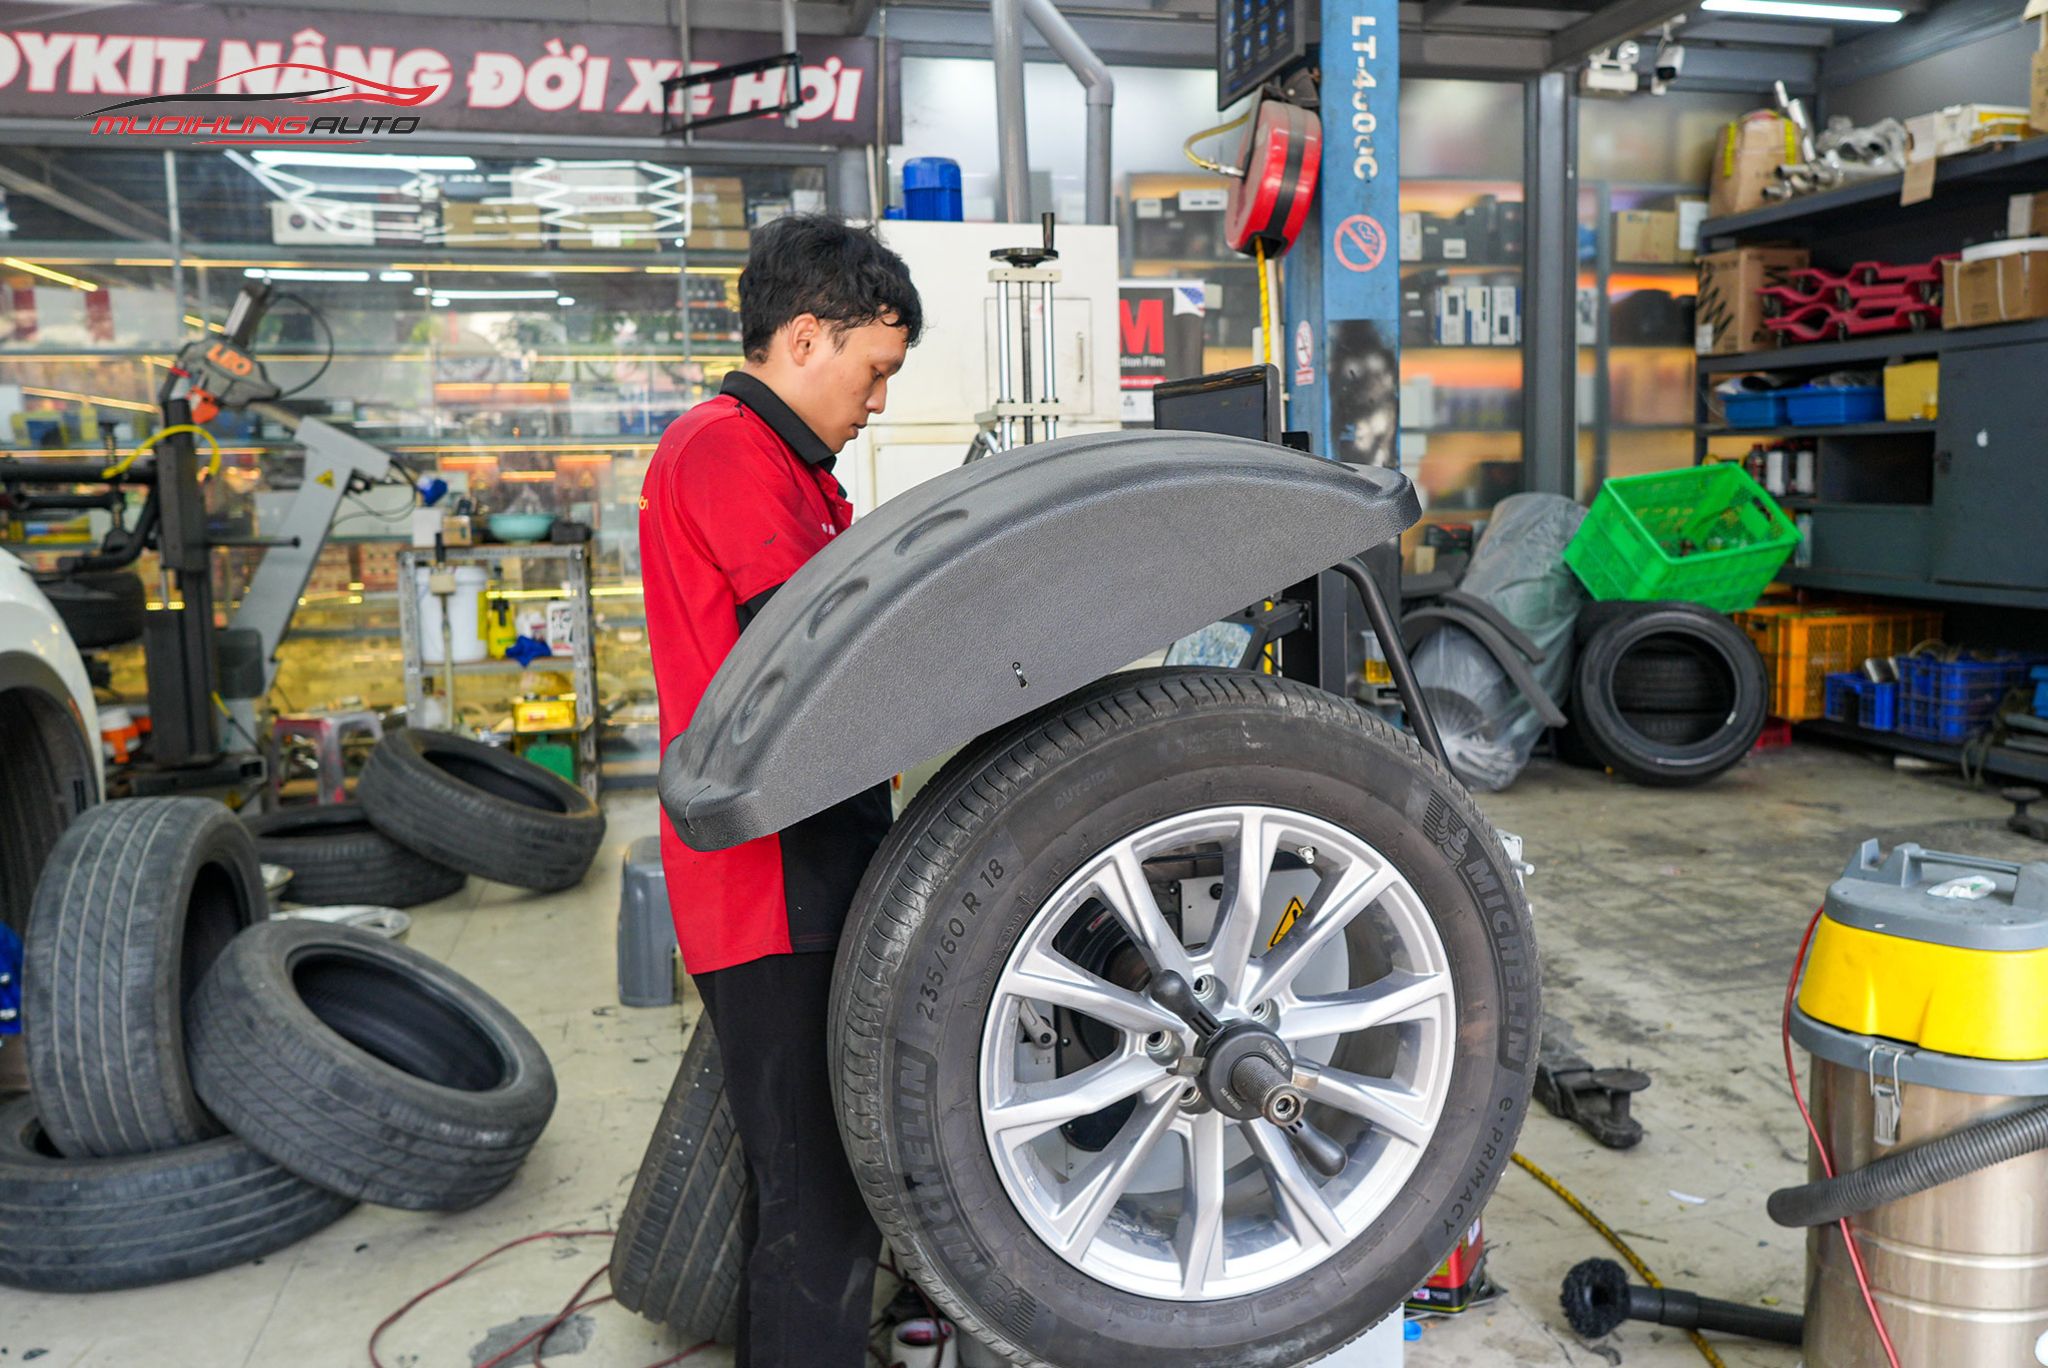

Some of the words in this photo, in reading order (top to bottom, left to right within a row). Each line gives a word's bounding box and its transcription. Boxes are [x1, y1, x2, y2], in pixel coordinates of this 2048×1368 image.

[216, 27, 454, 107] NÂNG
[467, 38, 610, 112] ĐỜI
[615, 58, 718, 115] XE
[728, 56, 863, 122] HƠI
[916, 917, 966, 1022] 235/60
[961, 891, 982, 916] R
[979, 858, 1005, 889] 18
[1465, 857, 1530, 1063] MICHELIN
[900, 1054, 987, 1278] MICHELIN
